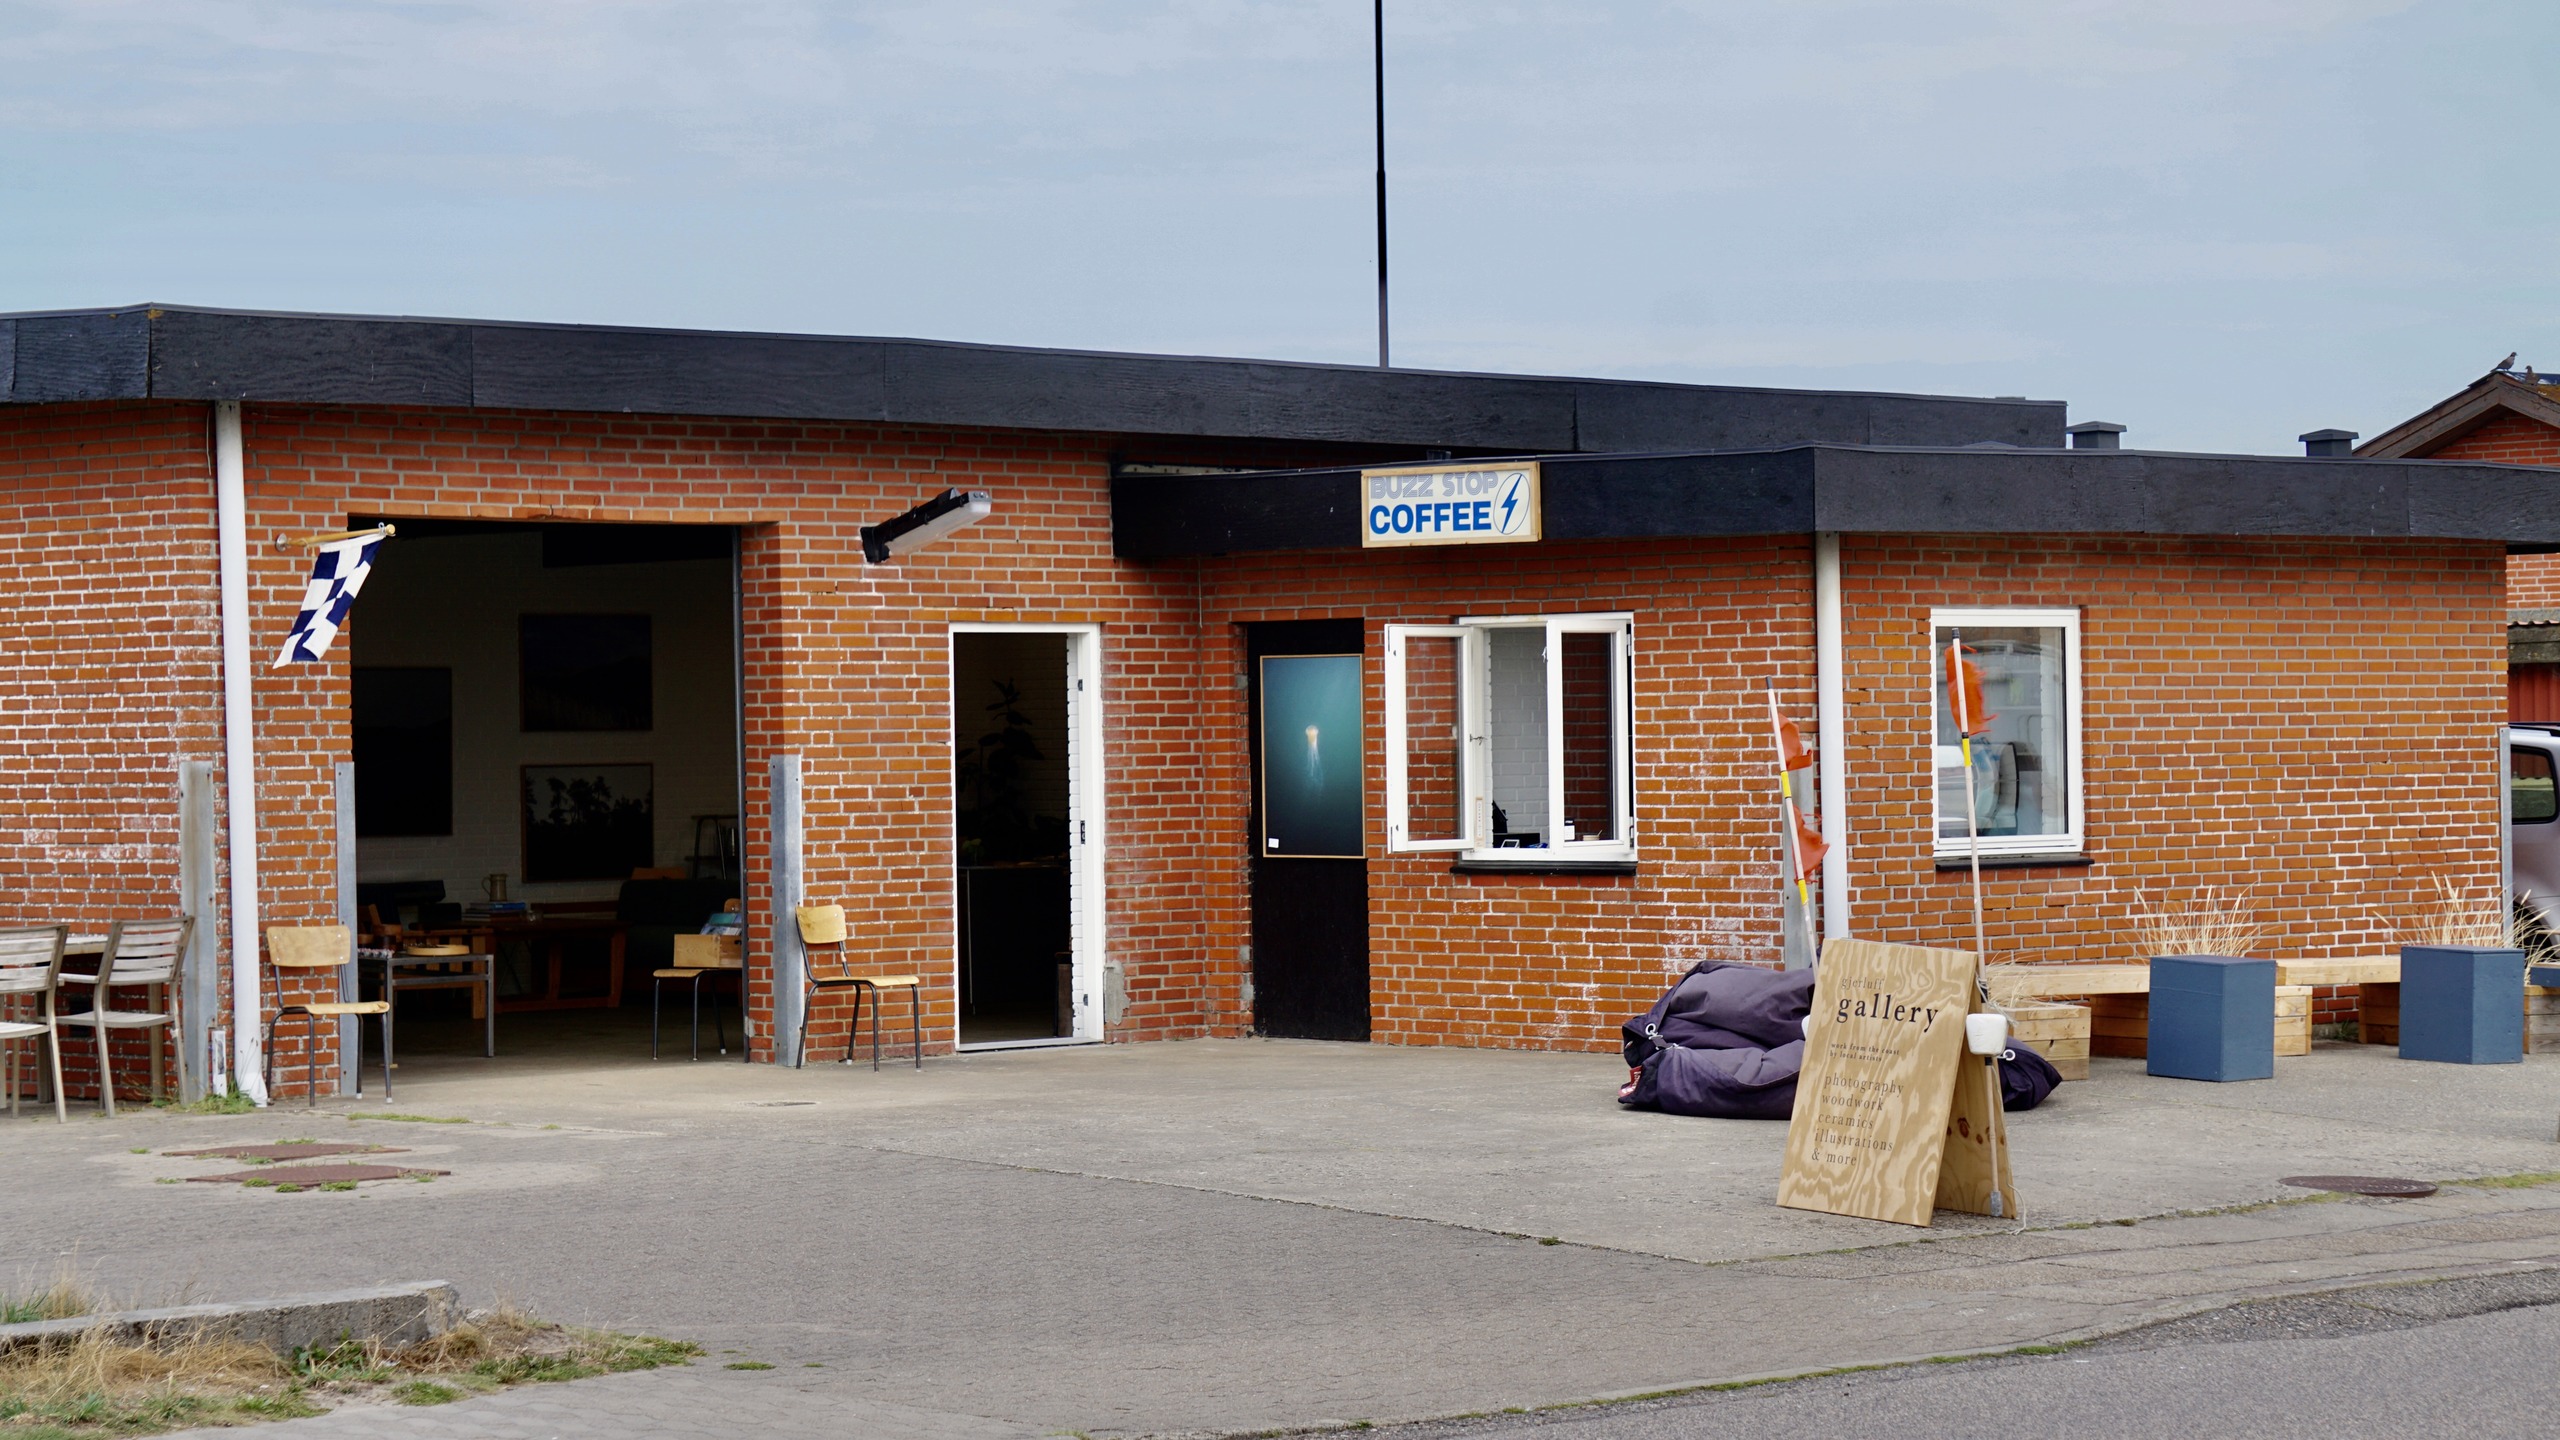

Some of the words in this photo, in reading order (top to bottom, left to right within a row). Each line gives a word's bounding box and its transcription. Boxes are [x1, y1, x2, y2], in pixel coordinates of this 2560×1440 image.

[1370, 474, 1433, 499] BUZZ
[1442, 471, 1498, 497] STOP
[1370, 501, 1492, 535] COFFEE
[1841, 976, 1885, 990] gjerluff
[1836, 993, 1939, 1033] gallery
[1830, 1050, 1837, 1059] by
[1839, 1052, 1857, 1060] local
[1858, 1054, 1882, 1063] artists
[1849, 1043, 1866, 1052] from
[1868, 1045, 1879, 1054] the
[1881, 1048, 1900, 1056] coast
[1824, 1072, 1904, 1098] photography
[1822, 1094, 1884, 1111] woodwork
[1818, 1113, 1874, 1130] ceramics
[1814, 1128, 1894, 1152] illustrations
[1811, 1147, 1820, 1161] &
[1826, 1153, 1857, 1167] more
